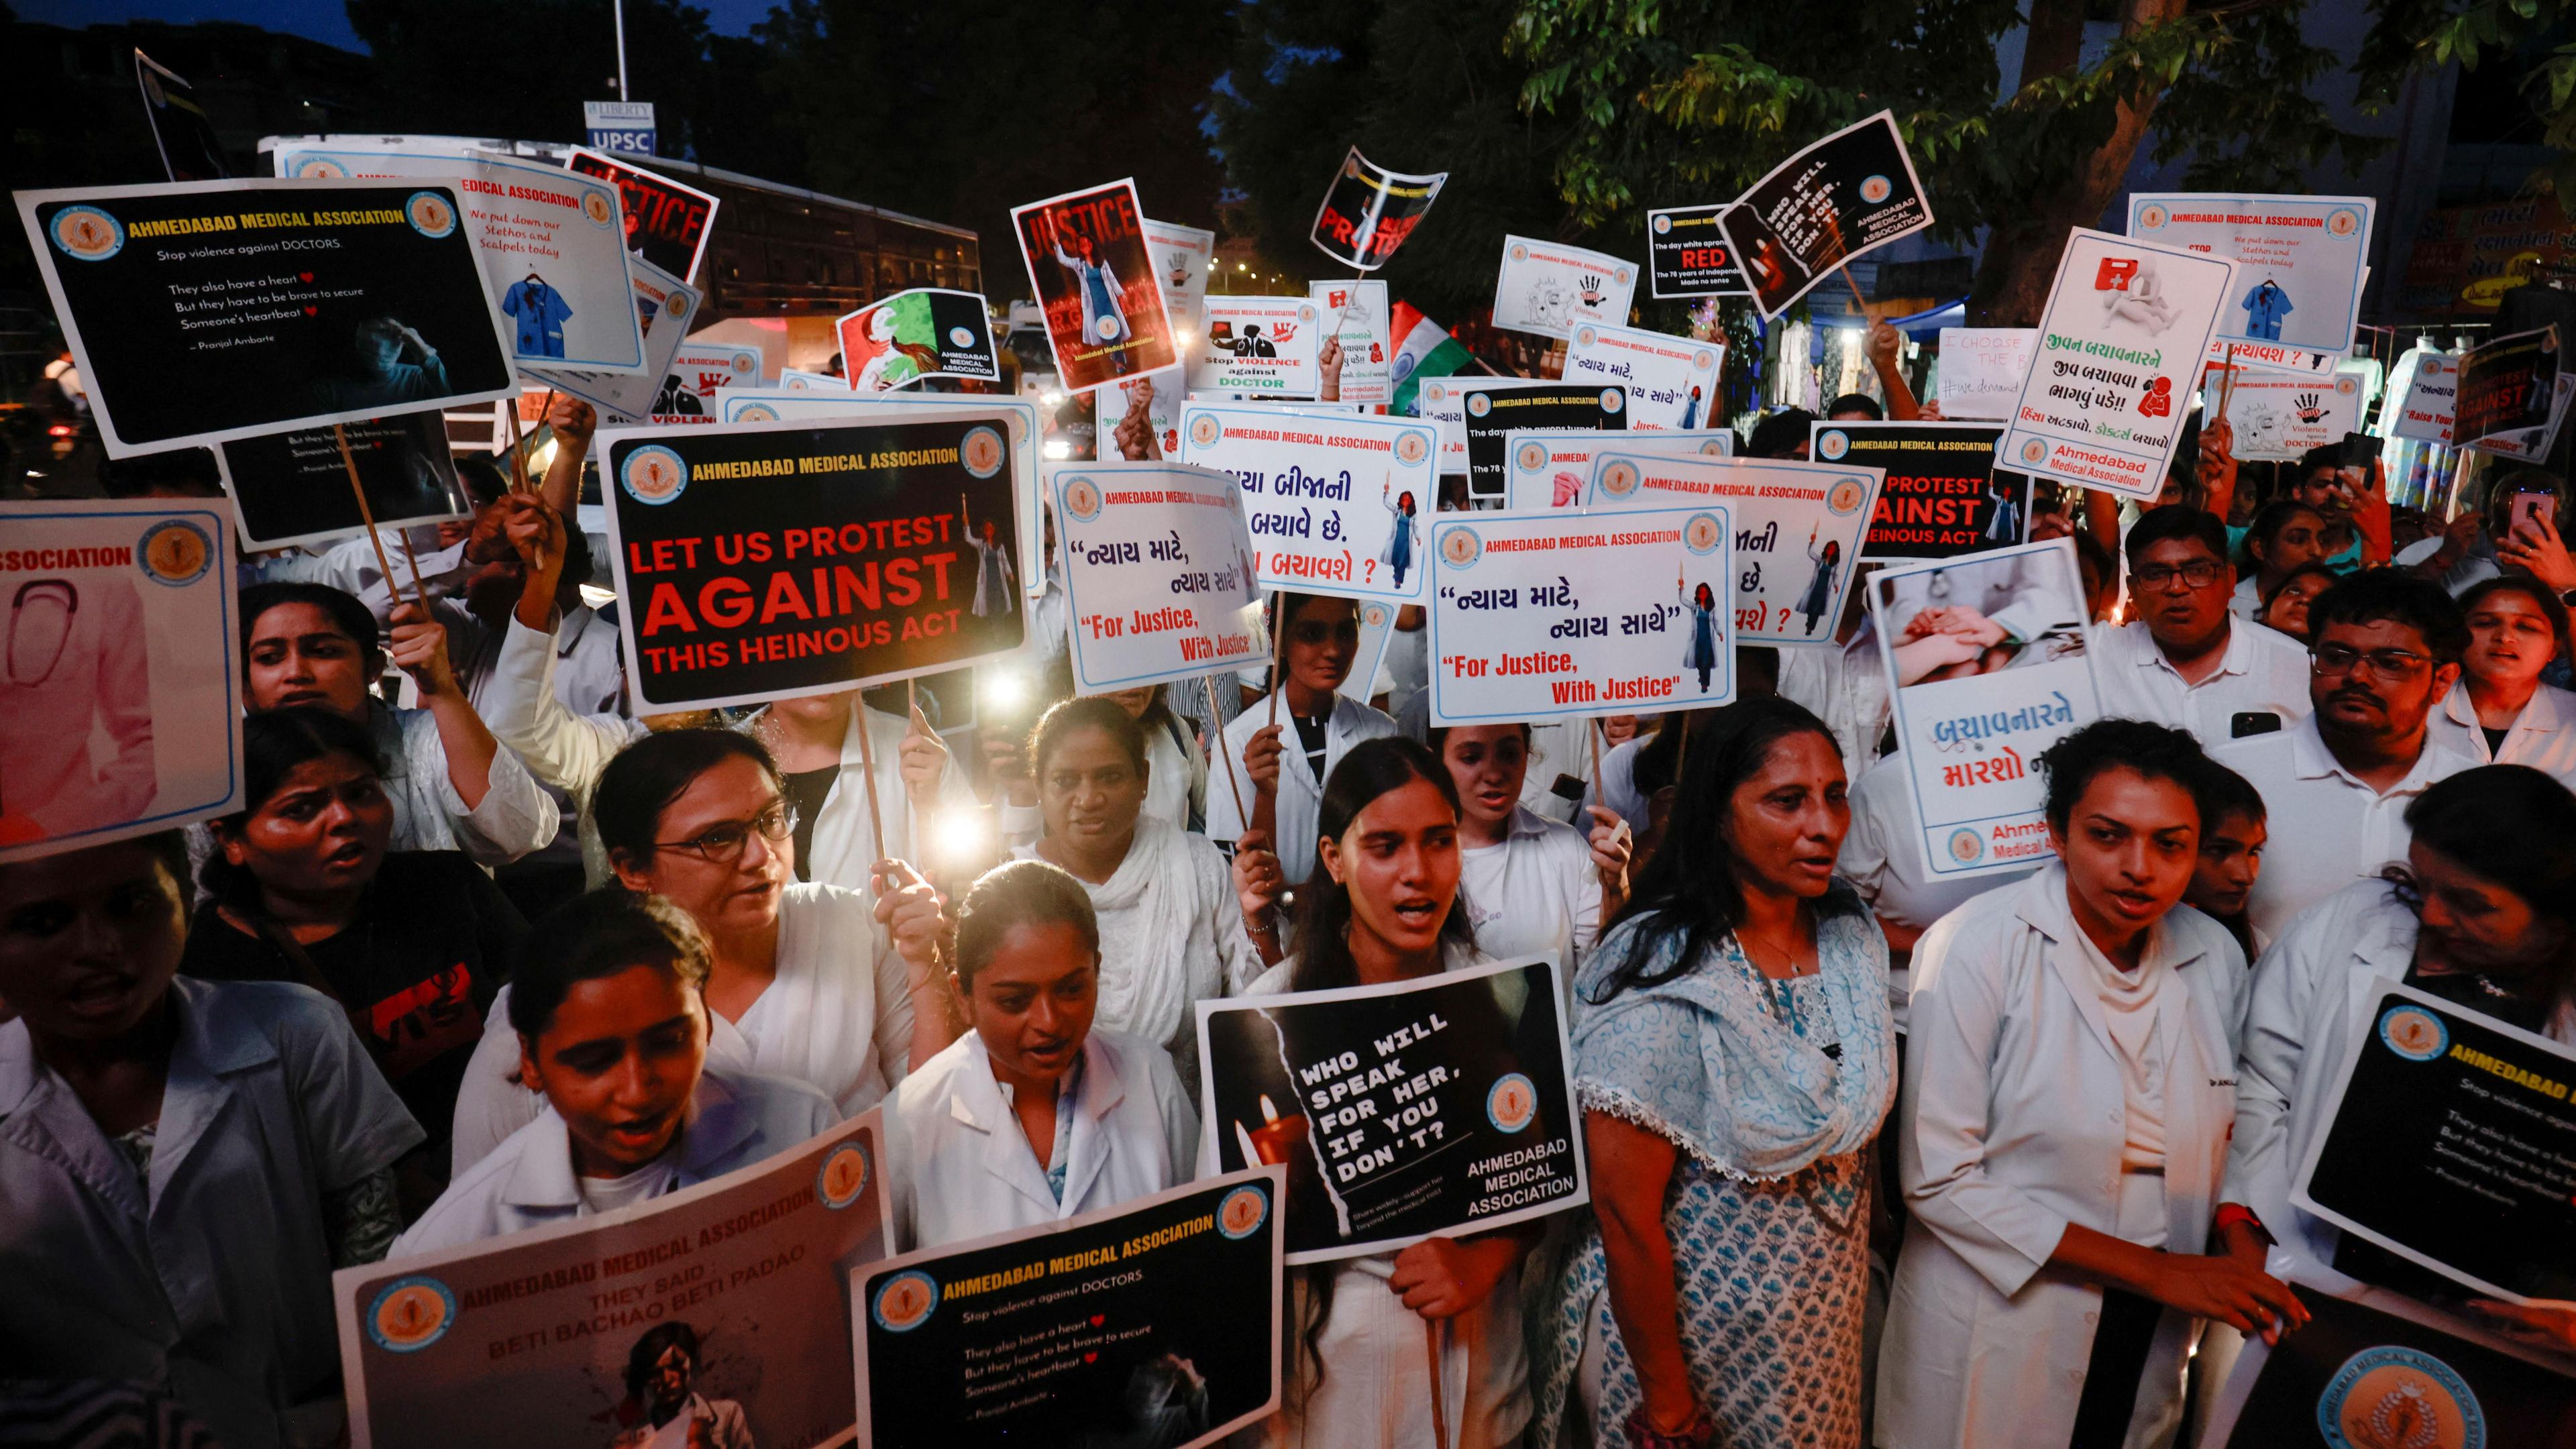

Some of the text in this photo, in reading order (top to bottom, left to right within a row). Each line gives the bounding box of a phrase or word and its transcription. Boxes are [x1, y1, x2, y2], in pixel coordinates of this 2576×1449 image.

[599, 104, 649, 115] LIBERTY
[594, 131, 649, 150] UPSC
[508, 184, 579, 209] ASSOCIATION
[1767, 161, 1827, 223] WHO WILL
[129, 209, 405, 238] AHMEDABAD MEDICAL ASSOCIATION
[470, 209, 560, 230] We put down our
[1857, 197, 1917, 227] AHMEDABAD
[1869, 211, 1911, 232] MEDICAL
[2171, 213, 2323, 227] AHMEDABAD MEDICAL ASSOCIATION
[485, 225, 551, 243] Stethos and
[1028, 195, 1139, 260] JUSTICE
[1863, 213, 1924, 244] ASSOCIATION
[157, 248, 186, 263] Stop
[189, 245, 235, 260] violence
[238, 241, 278, 257] against
[480, 237, 559, 259] Scalpels today
[1682, 249, 1726, 268] RED
[169, 273, 297, 298] They also have a heart
[180, 307, 301, 331] Someone's heartbeat
[198, 334, 274, 354] Pranjal Ambarte
[1597, 336, 1693, 361] AHMEDABAD MEDICAL ASSOCIATION
[1944, 336, 2022, 349] I CHOOSE
[2046, 334, 2161, 368] જીવન બચાવનારને
[942, 352, 989, 361] AHMEDABAD
[943, 365, 992, 374] ASSOCIATION
[950, 359, 983, 368] MEDICAL
[1205, 356, 1300, 366] Stop VIOLENCE
[1978, 353, 2008, 366] THE
[1220, 378, 1284, 388] DOCTOR
[1610, 362, 1633, 381] માટે,
[2053, 361, 2137, 388] જીવ બચાવવા
[1978, 378, 2019, 394] demand
[2049, 385, 2126, 412] ભાગવું પડે!!
[1493, 398, 1530, 408] AHMEDABAD
[1561, 397, 1599, 405] ASSOCIATION
[2021, 407, 2045, 423] હિંસા
[2133, 433, 2168, 449] બચાવો
[2435, 414, 2454, 426] Your
[1223, 427, 1391, 451] AHMEDABAD MEDICAL ASSOCIATION
[1850, 440, 1993, 452] AHMEDABAD MEDICAL ASSOCIATION
[693, 448, 958, 481] AHMEDABAD MEDICAL ASSOCIATION
[2050, 458, 2141, 487] Medical Association
[2055, 445, 2147, 473] Ahmedabad
[1275, 466, 1351, 502] બીજાની
[1886, 476, 1983, 494] PROTEST
[1106, 490, 1226, 508] AHMEDABAD MEDICAL ASSOCIATION
[1252, 508, 1347, 542] બચાવે છે.
[1939, 531, 1979, 545] ACT
[630, 514, 953, 573] LET US PROTEST
[1071, 530, 1189, 566] “ન્યાય માટે,
[1485, 529, 1680, 553] AHMEDABAD MEDICAL ASSOCIATION
[0, 546, 131, 572] SOCIATION
[1271, 551, 1376, 583] બચાવશે ?
[642, 551, 957, 637] AGAINST
[1171, 571, 1209, 594] ન્યાય
[1440, 576, 1579, 610] “ન્યાય માટે,
[1130, 608, 1199, 635] Justice,
[1550, 602, 1680, 639] ન્યાય સાથે”
[644, 609, 960, 674] THIS HEINOUS ACT
[1180, 634, 1213, 661] With
[1442, 651, 1578, 678] “For Justice,
[1552, 679, 1595, 704] With
[1934, 691, 2075, 744] બચાવનારને
[1943, 746, 2025, 788] મારશો
[1300, 1012, 1448, 1087] WHO WILL
[1311, 1058, 1406, 1111] SPEAK
[2449, 1043, 2569, 1099] AHMEDABAD
[1319, 1066, 1462, 1136] FOR HER,
[1328, 1097, 1440, 1161] IF YOU
[1467, 1137, 1567, 1179] AHMEDABAD
[1485, 1160, 1556, 1194] MEDICAL
[1467, 1176, 1575, 1218] ASSOCIATION
[463, 1185, 815, 1312] AHMEDABAD MEDICAL ASSOCIATION
[943, 1214, 1214, 1301] AHMEDABAD MEDICAL ASSOCIATION
[590, 1265, 705, 1311] THEY SAID
[488, 1244, 805, 1361] BETI BACHAO BETI PADAO
[963, 1311, 989, 1324] Stop
[993, 1297, 1035, 1316] violence
[1038, 1287, 1078, 1304] against
